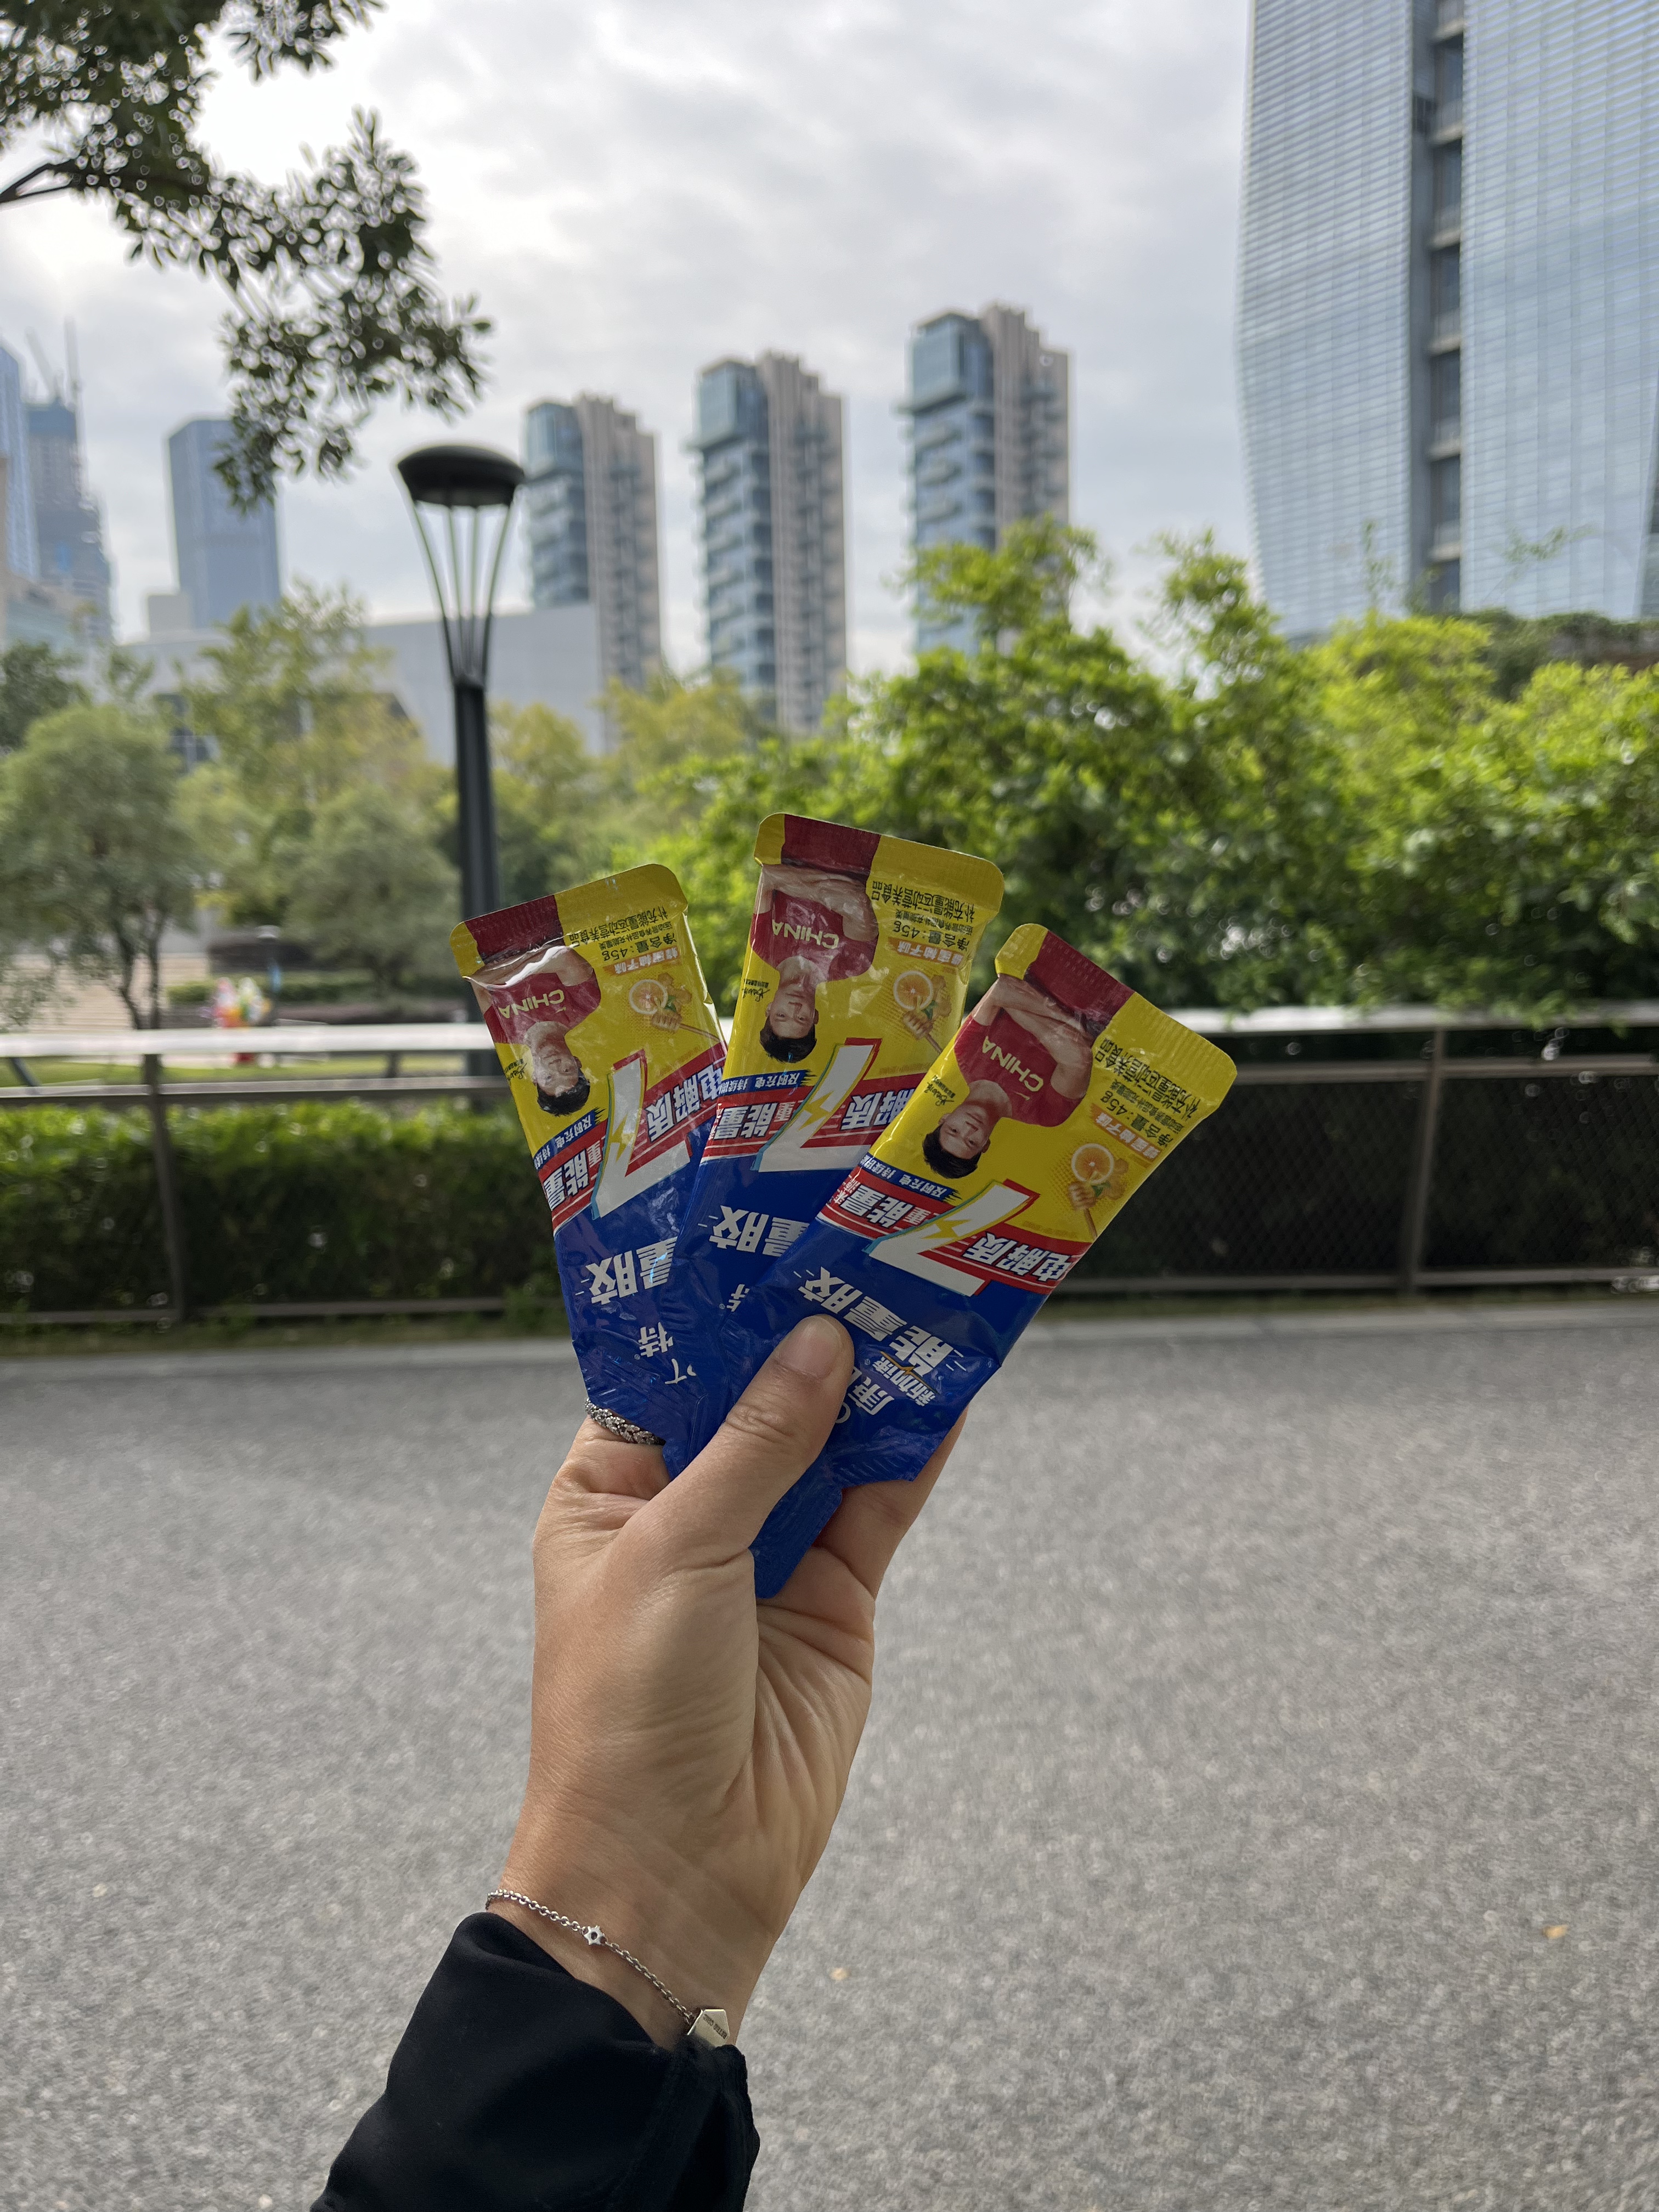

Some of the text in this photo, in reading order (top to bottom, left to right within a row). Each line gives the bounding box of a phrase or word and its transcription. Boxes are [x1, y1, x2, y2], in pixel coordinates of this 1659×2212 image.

[871, 880, 975, 923] 补充能量运动营养食品
[568, 906, 668, 948] 补充能量运动营养食品
[772, 919, 839, 950] CHINA
[498, 988, 563, 1019] CHINA
[754, 1073, 800, 1087] 及时充电
[978, 1035, 1045, 1094] CHINA
[1093, 1037, 1201, 1121] 补充能量运动营养食品
[645, 1064, 720, 1141] 电解质
[554, 1114, 591, 1148] 及时充电
[898, 1173, 947, 1198] 及时充电
[962, 1231, 1071, 1282] 电解质
[797, 1266, 953, 1376] 能量胶
[871, 1356, 935, 1407] 新加速
